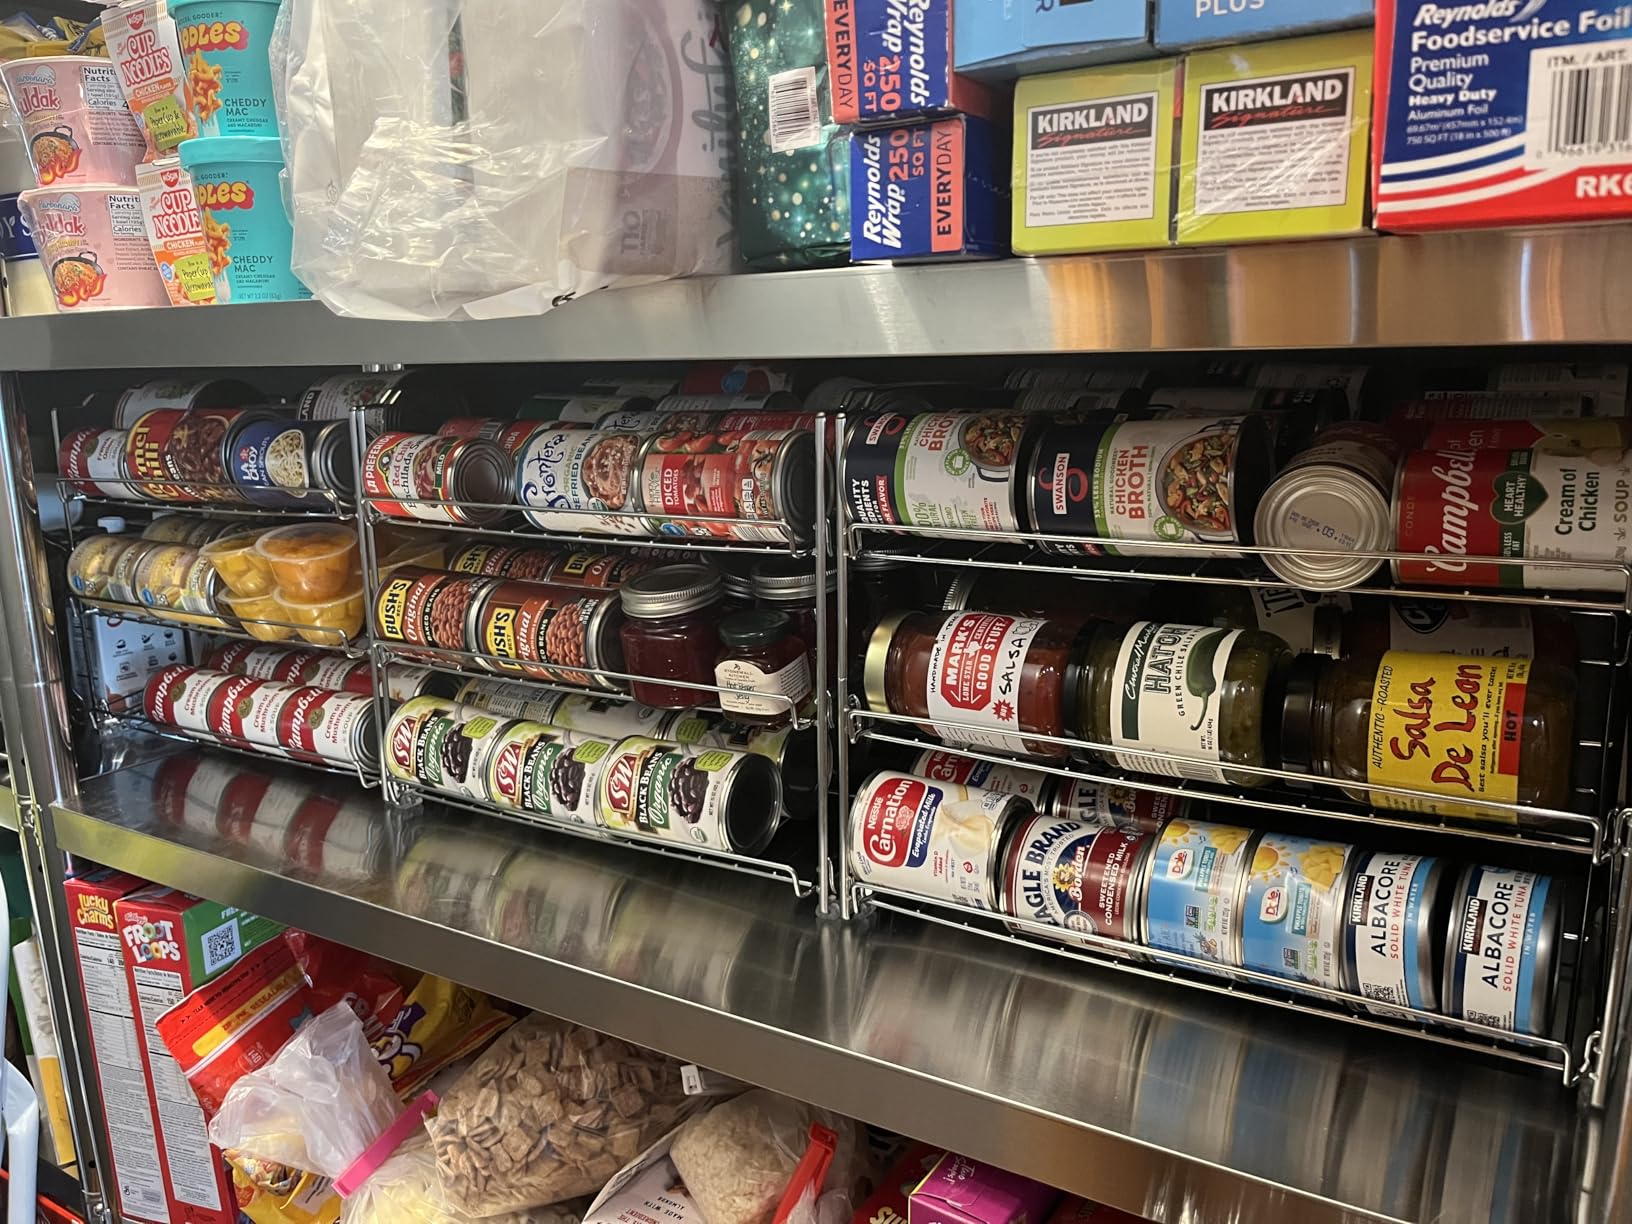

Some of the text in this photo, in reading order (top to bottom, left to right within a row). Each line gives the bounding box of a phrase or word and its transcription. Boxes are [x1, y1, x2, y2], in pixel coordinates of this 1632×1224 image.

[1411, 6, 1632, 53] Foodservice Foil
[1412, 0, 1522, 28] Reynolds
[127, 31, 156, 58] CUP
[834, 0, 854, 109] EVERYDAY
[910, 0, 931, 106] Reynolds
[1409, 52, 1489, 74] Premium
[85, 74, 111, 83] Facts
[862, 61, 876, 113] SQ FT
[880, 55, 902, 111] 250
[1211, 78, 1343, 114] KIRKLAND
[1408, 73, 1474, 94] Quality
[1408, 87, 1497, 107] Heavy Duty
[224, 98, 267, 107] CHEDDY
[226, 107, 249, 117] MAC
[1037, 101, 1148, 135] KIRKLAND
[1211, 102, 1340, 128] Signature
[1407, 104, 1489, 121] Aluminum Foil
[913, 127, 926, 177] SQ FT
[1037, 124, 1149, 149] Signature
[1422, 133, 1437, 145] SQ
[109, 202, 136, 210] Facts
[161, 190, 192, 216] CUP
[862, 133, 883, 244] Reynolds
[880, 128, 909, 250] Wrap 250
[935, 130, 953, 238] EVERYDAY
[112, 225, 142, 234] Calories
[232, 255, 274, 265] CHEDDY
[234, 264, 257, 274] MAC
[237, 463, 252, 482] LA
[248, 445, 260, 481] CHOY
[365, 433, 397, 495] LA PREFERIDA
[391, 471, 402, 487] Red
[435, 453, 446, 476] MILD
[1054, 455, 1068, 512] SWANSON
[1114, 449, 1130, 516] CHICKEN
[1127, 443, 1150, 520] BROTH
[661, 467, 674, 507] DICED
[672, 468, 681, 508] TOMATOES
[877, 478, 890, 510] FLAVOR
[1503, 480, 1516, 513] HEART
[1512, 476, 1528, 519] HEALTHY
[1553, 466, 1578, 536] Cream of
[1577, 470, 1601, 533] Chicken
[1613, 478, 1630, 524] SOUP
[1510, 538, 1521, 552] FAT
[385, 581, 408, 636] BUSH'S
[395, 600, 405, 618] BEST
[404, 581, 427, 642] Original
[425, 587, 441, 642] BAKED BEANS
[539, 616, 550, 643] BEANS
[929, 614, 960, 694] HANDMADE TEXAS
[944, 618, 977, 687] MARK'S
[976, 616, 1009, 692] GOOD STUFF
[998, 637, 1028, 696] SALSA
[1142, 625, 1191, 695] HATCH
[961, 658, 974, 702] LONE STAR
[1172, 634, 1196, 718] GREEN CHILE SALSA
[183, 690, 195, 713] Cream
[253, 693, 271, 729] Cream of
[259, 691, 281, 733] Mushroom
[324, 703, 342, 739] Cream of
[332, 701, 353, 745] Mushroom
[342, 711, 354, 735] SOUP
[1371, 665, 1394, 770] AUTHENTIC ROASTED
[1389, 676, 1437, 762] Salsa
[416, 714, 439, 781] BLACK BEANS
[1430, 663, 1483, 793] De Leon
[1503, 709, 1520, 743] HOT
[425, 722, 446, 783] Organic
[523, 740, 547, 808] BLACK BEANS
[1478, 772, 1486, 793] Best
[1482, 710, 1490, 743] you'll
[532, 746, 555, 811] Organic
[638, 750, 664, 825] BLACK BEANS
[648, 757, 673, 826] Organic
[868, 778, 915, 864] Carnation
[911, 791, 938, 859] Evaporated Milk
[1024, 821, 1082, 866] BRAND
[1043, 833, 1075, 916] AMERICA'S MOST TRUSTED
[1068, 845, 1087, 902] Borden
[1098, 852, 1116, 909] SWEETENED
[1104, 841, 1129, 927] CONDENSED MILK
[1171, 850, 1189, 875] Dole
[76, 907, 115, 931] Charms
[78, 892, 109, 915] Lucky
[1264, 888, 1282, 917] Dole
[1351, 874, 1368, 925] KIRKLAND
[1370, 858, 1401, 957] ALBACORE
[1390, 860, 1413, 960] SOLID WHITE TUNA
[1406, 881, 1419, 922] IN WATER
[122, 919, 174, 949] FROOT
[1461, 897, 1481, 953] KIRKLAND
[1481, 881, 1515, 989] ALBACORE
[1502, 883, 1529, 993] SOLID WHITE TUNA
[1523, 911, 1537, 957] IN WATER
[131, 940, 182, 964] LOOPS
[643, 1200, 685, 1222] MADE WITH
